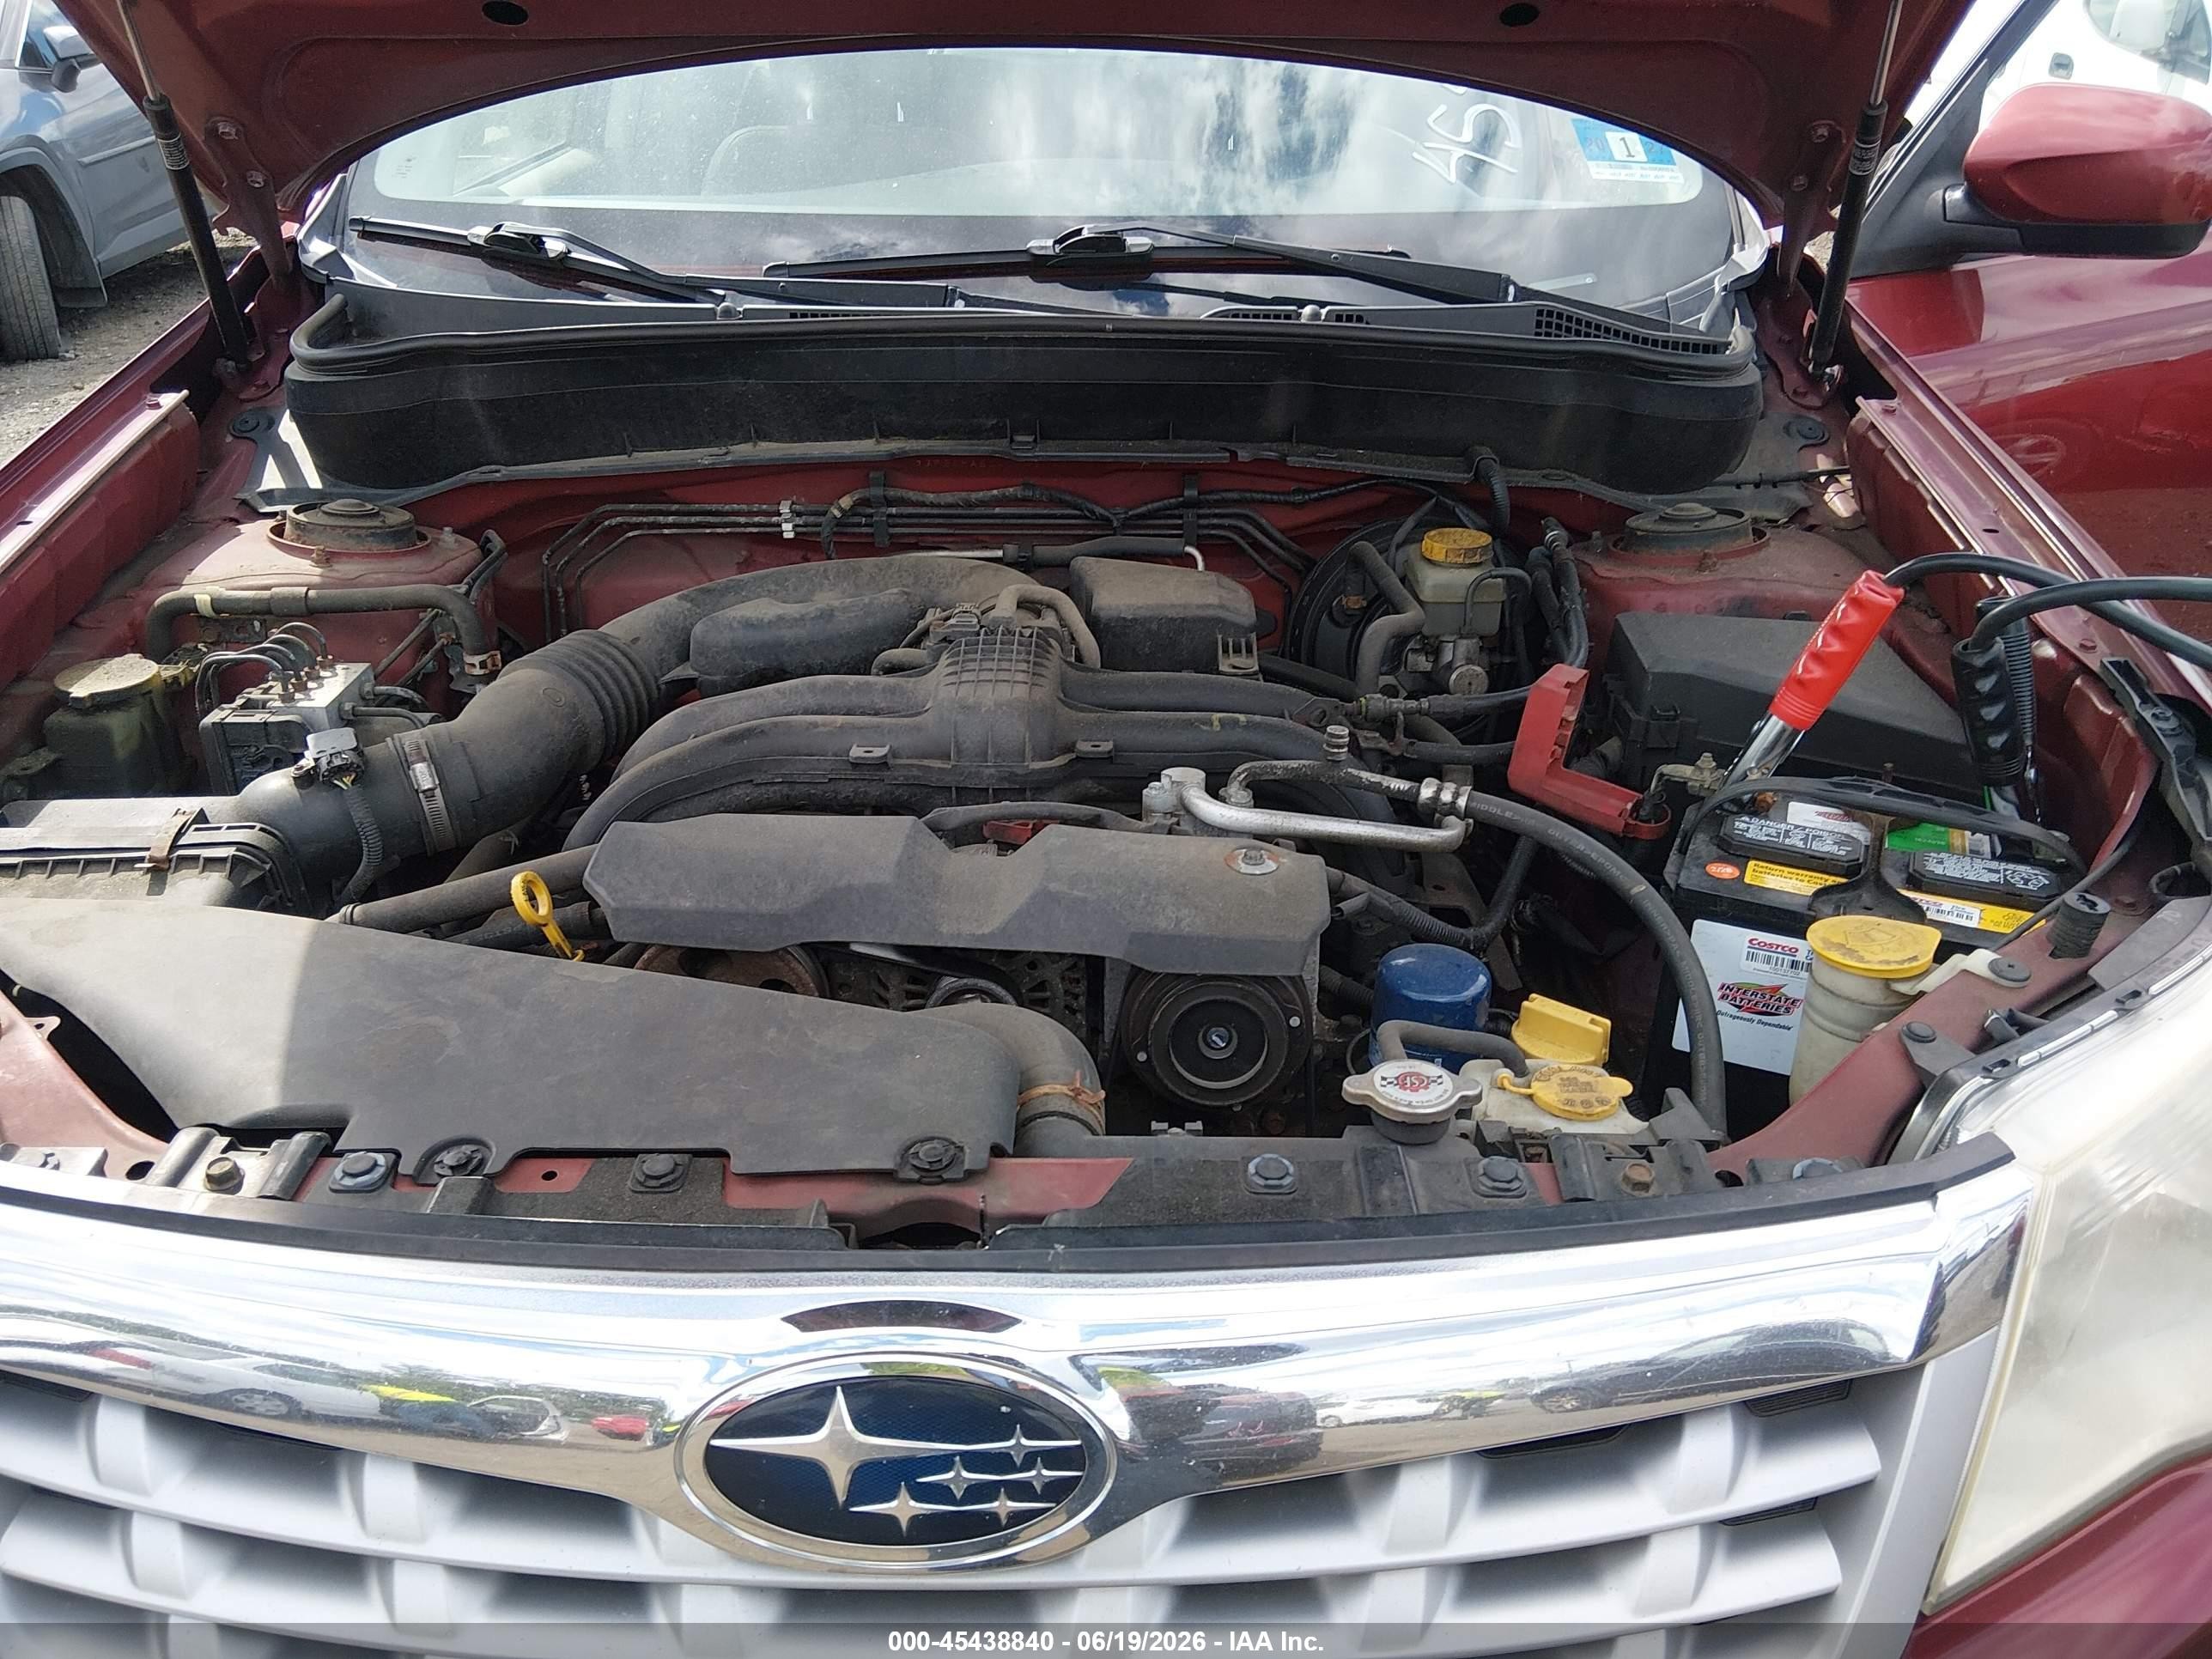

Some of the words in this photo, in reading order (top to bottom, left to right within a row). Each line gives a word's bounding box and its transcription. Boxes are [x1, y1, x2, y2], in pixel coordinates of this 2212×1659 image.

[1413, 84, 1522, 183] 45
[1620, 137, 1635, 157] 1
[1750, 817, 1795, 830] DANGER
[1805, 828, 1847, 840] POISON
[1752, 868, 1794, 880] batteries
[1753, 862, 1785, 874] Return
[1787, 869, 1830, 883] warranty
[1748, 938, 1799, 953] COSTCO
[1718, 982, 1802, 1007] INTERSTATE
[1718, 993, 1793, 1014] BATTERIES
[1717, 1010, 1756, 1024] Outrageously
[1756, 1018, 1793, 1031] Dependable
[1402, 1075, 1427, 1087] CSF
